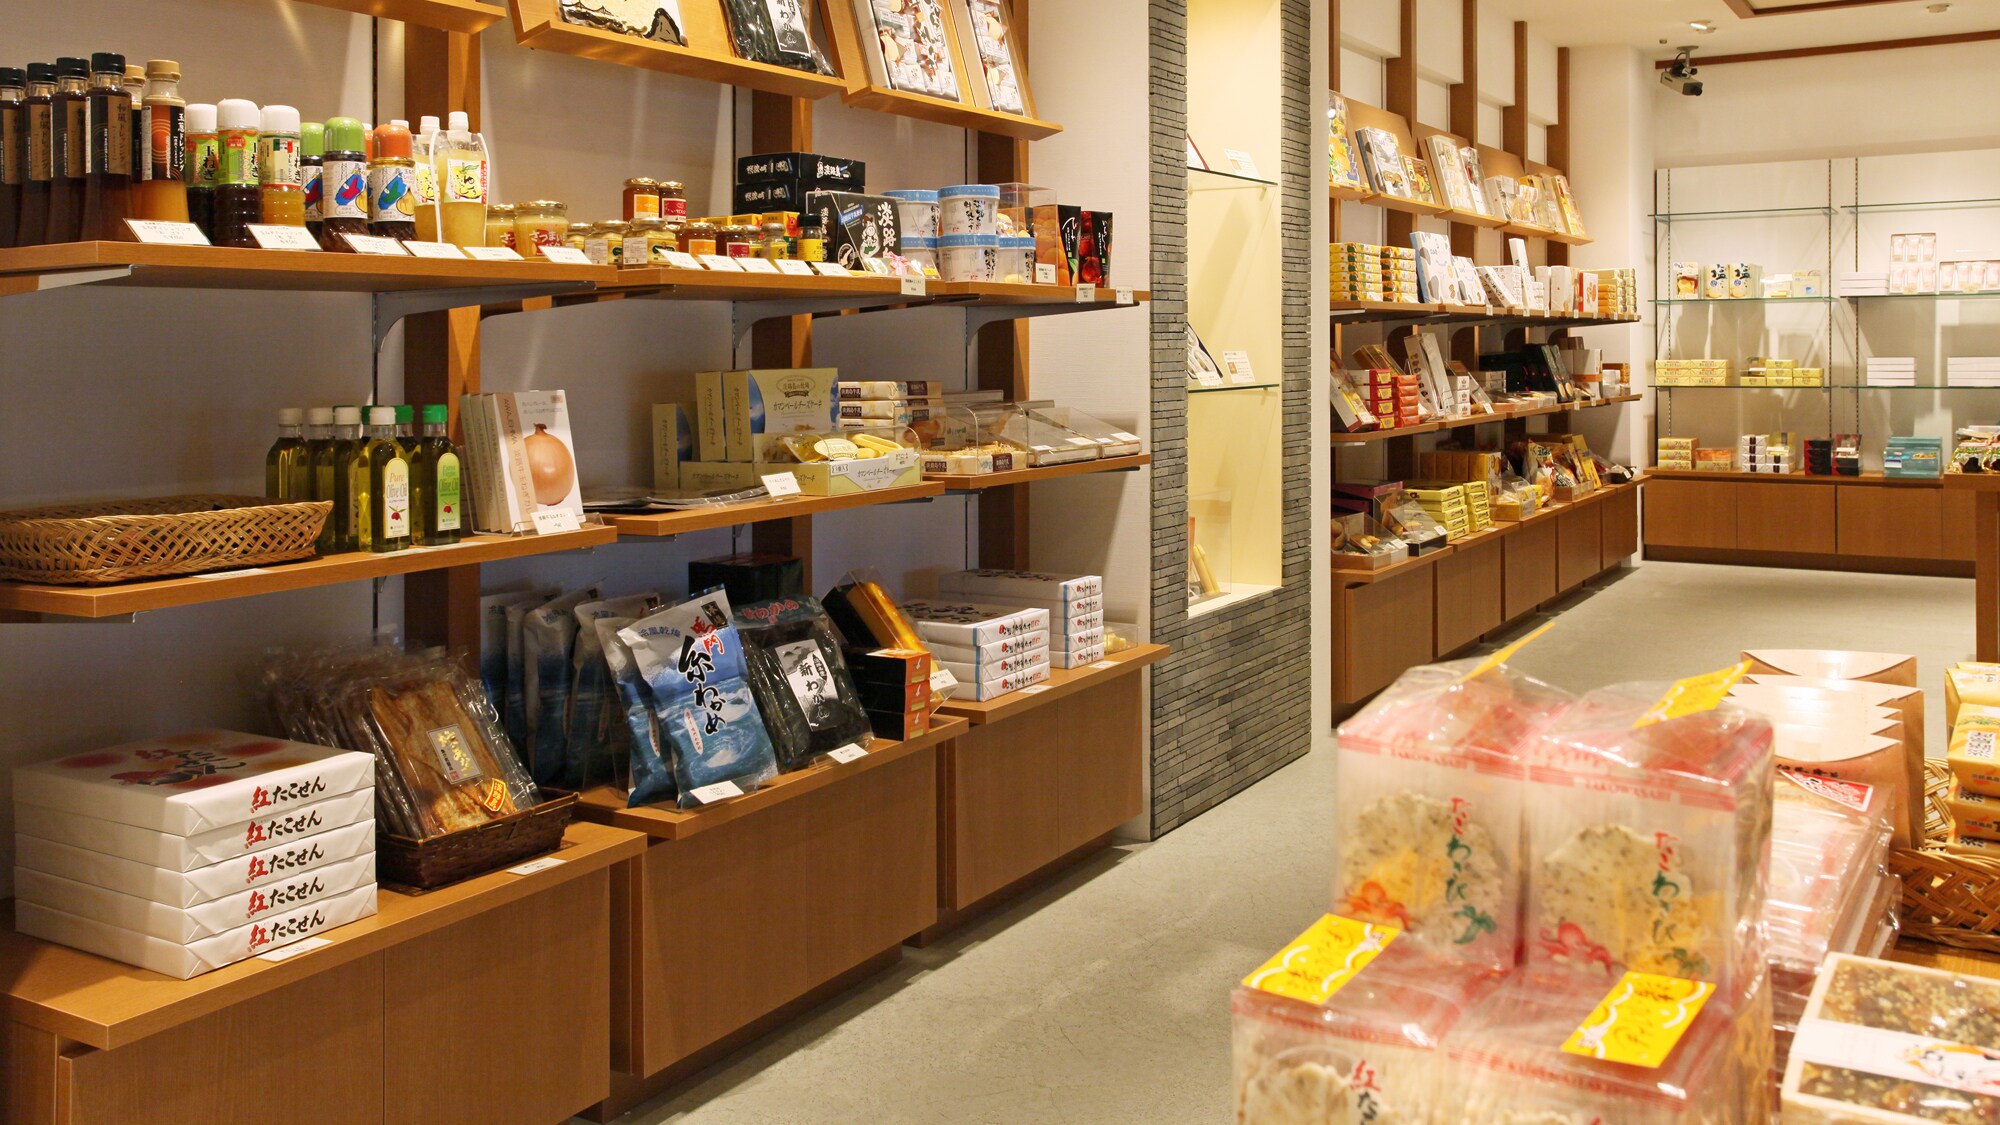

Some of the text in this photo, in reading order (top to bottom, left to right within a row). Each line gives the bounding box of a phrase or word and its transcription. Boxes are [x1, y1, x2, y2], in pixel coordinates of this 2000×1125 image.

[386, 484, 399, 499] Olive
[389, 472, 405, 483] Pure
[439, 478, 451, 492] Olive
[677, 634, 728, 736] 糸わかめ
[249, 775, 327, 813] 紅たこせん
[244, 809, 323, 849] 紅たこせん
[245, 842, 326, 884] 紅たこせん
[245, 876, 326, 919] 紅たこせん
[247, 909, 327, 952] 紅たこせん
[1349, 1059, 1382, 1125] 紅た
